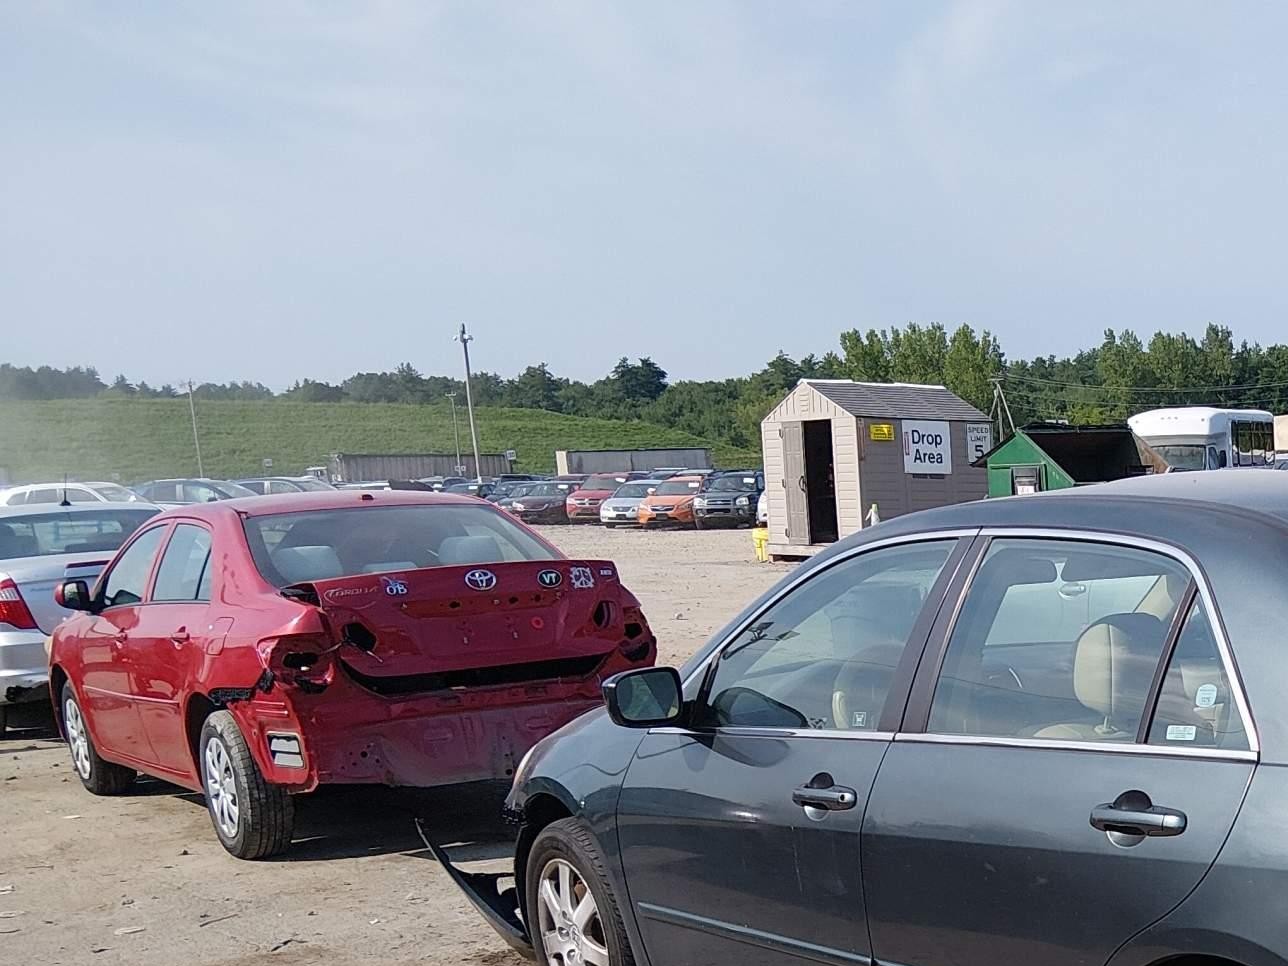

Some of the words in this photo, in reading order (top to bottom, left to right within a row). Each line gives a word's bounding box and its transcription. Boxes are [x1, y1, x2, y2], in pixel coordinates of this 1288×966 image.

[967, 426, 989, 434] SPEED
[911, 429, 943, 448] Drop
[913, 448, 943, 464] Area
[974, 444, 984, 459] 5
[542, 573, 557, 584] VT
[386, 583, 408, 595] OB
